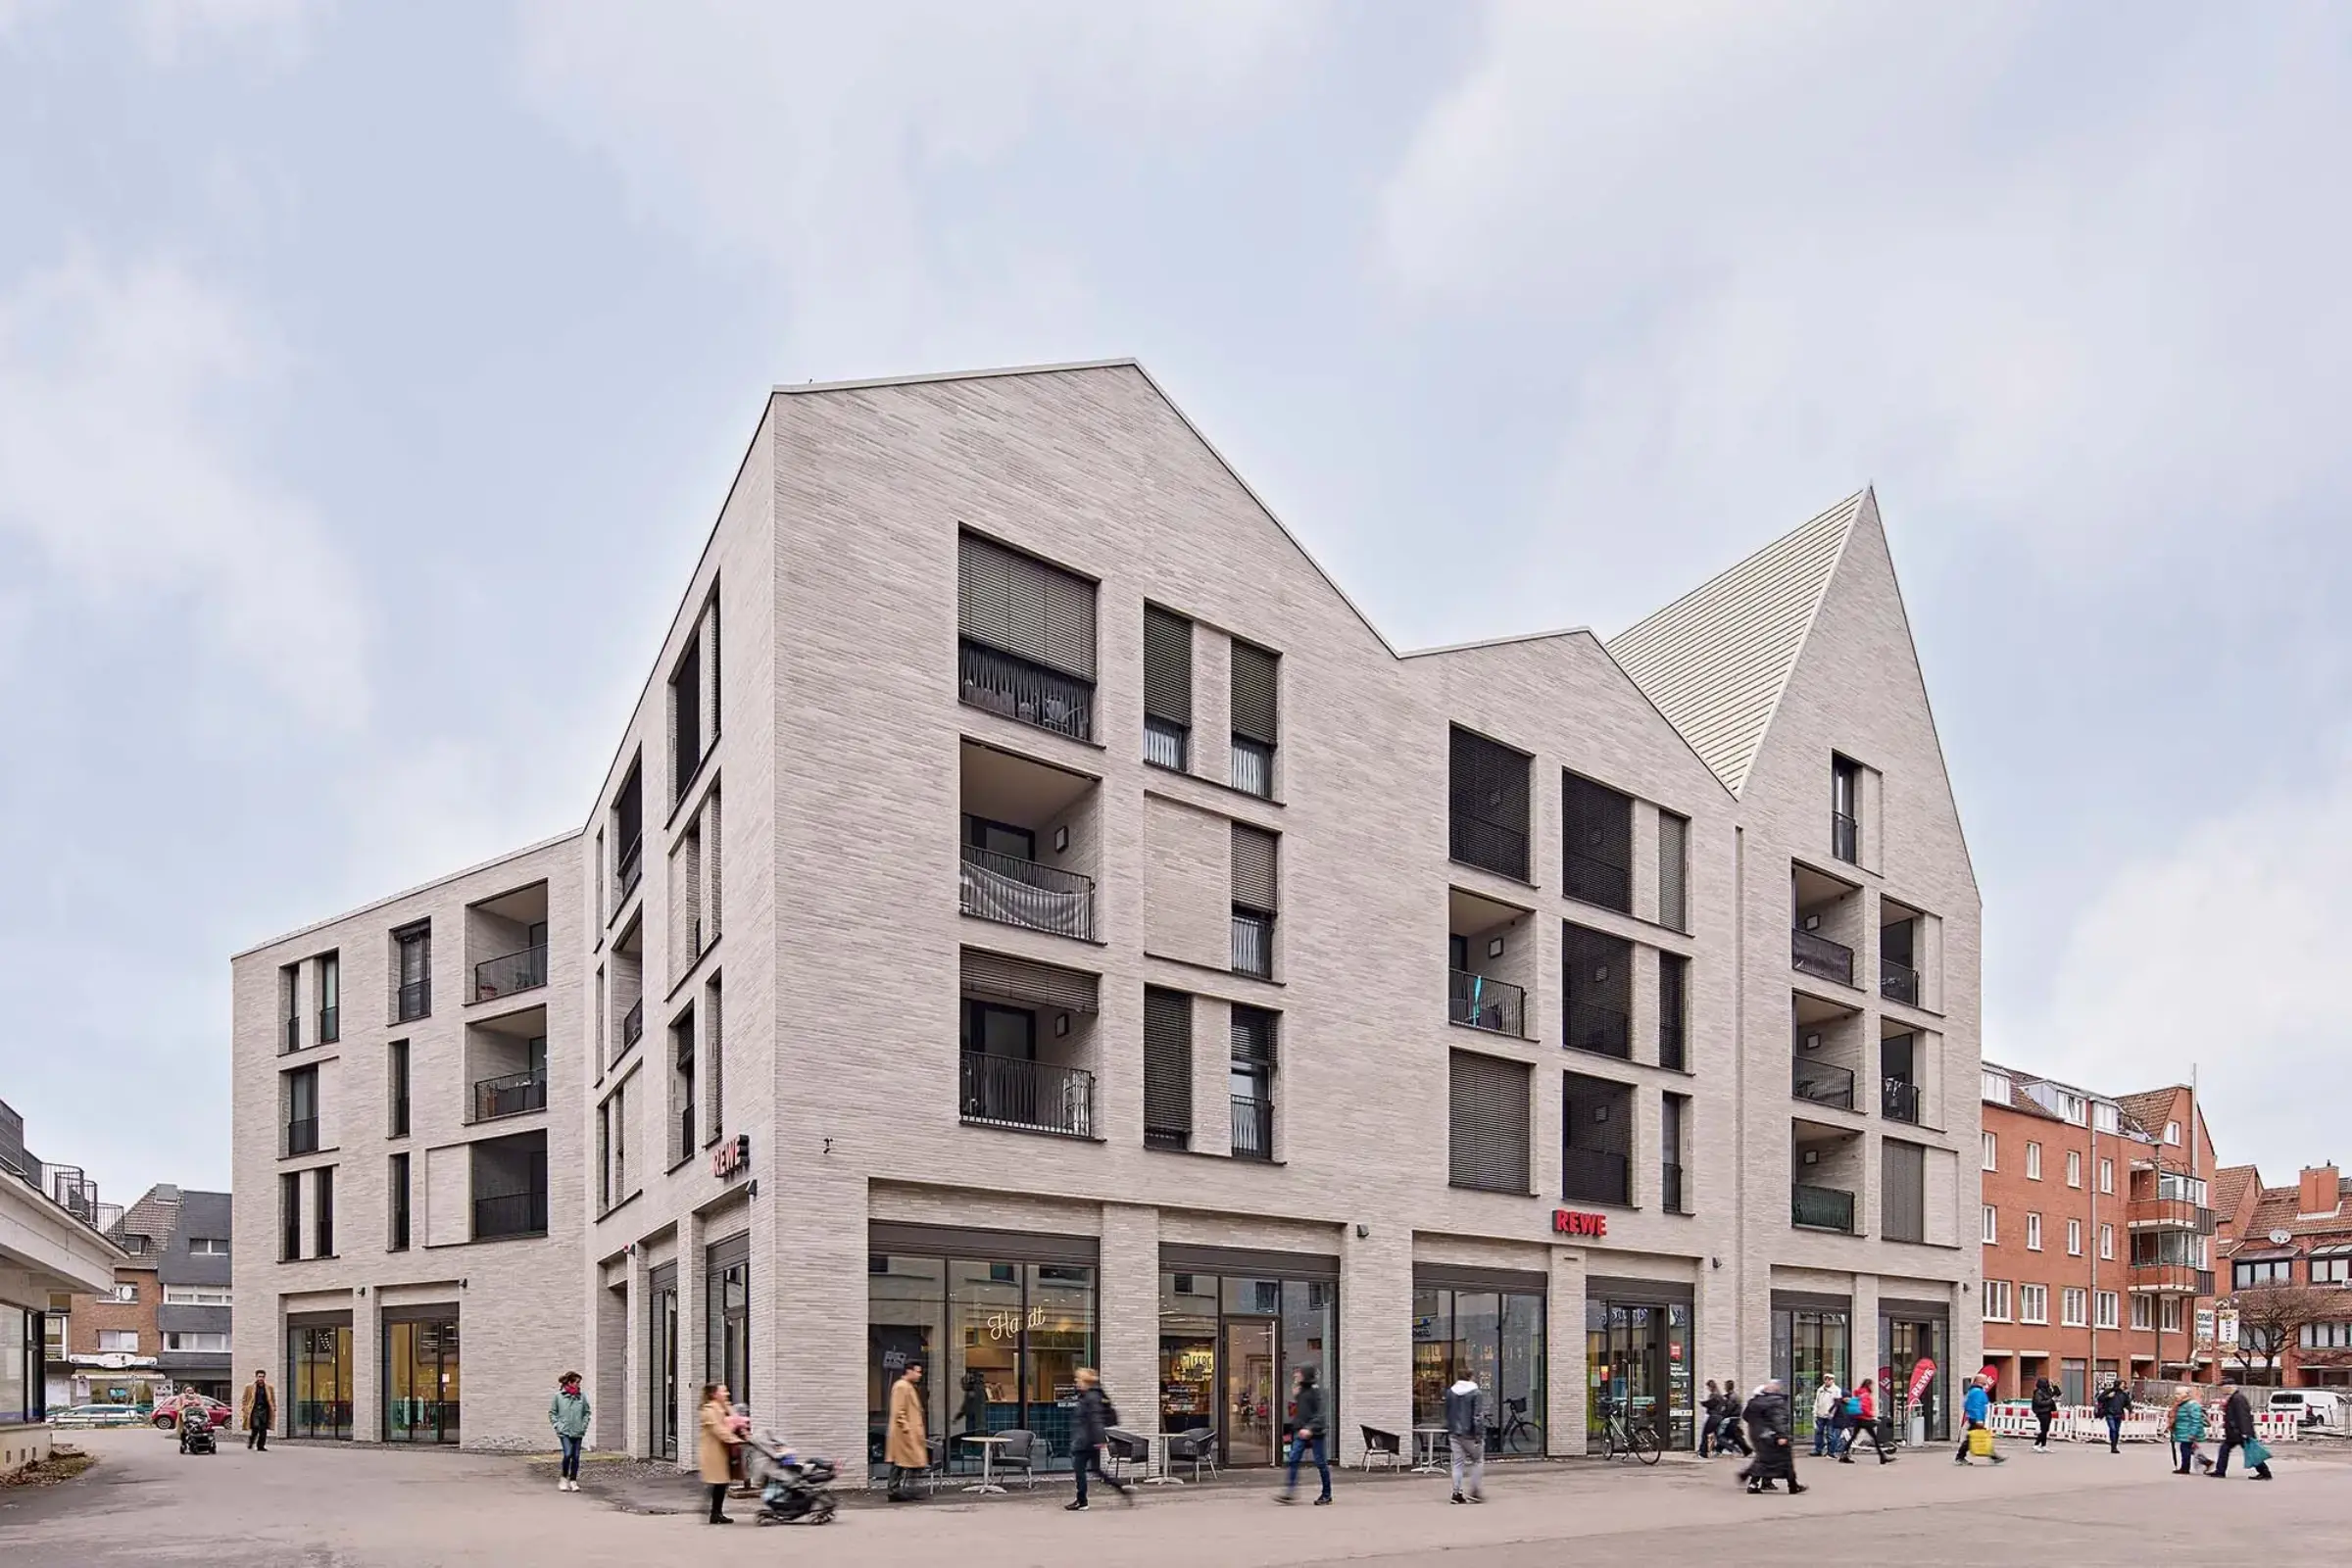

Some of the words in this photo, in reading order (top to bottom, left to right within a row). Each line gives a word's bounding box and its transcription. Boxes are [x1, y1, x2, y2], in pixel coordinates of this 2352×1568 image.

[712, 1135, 749, 1177] REWE
[1552, 1209, 1607, 1236] REWE
[987, 1305, 1046, 1340] Hadt
[1912, 1367, 1935, 1396] REWE
